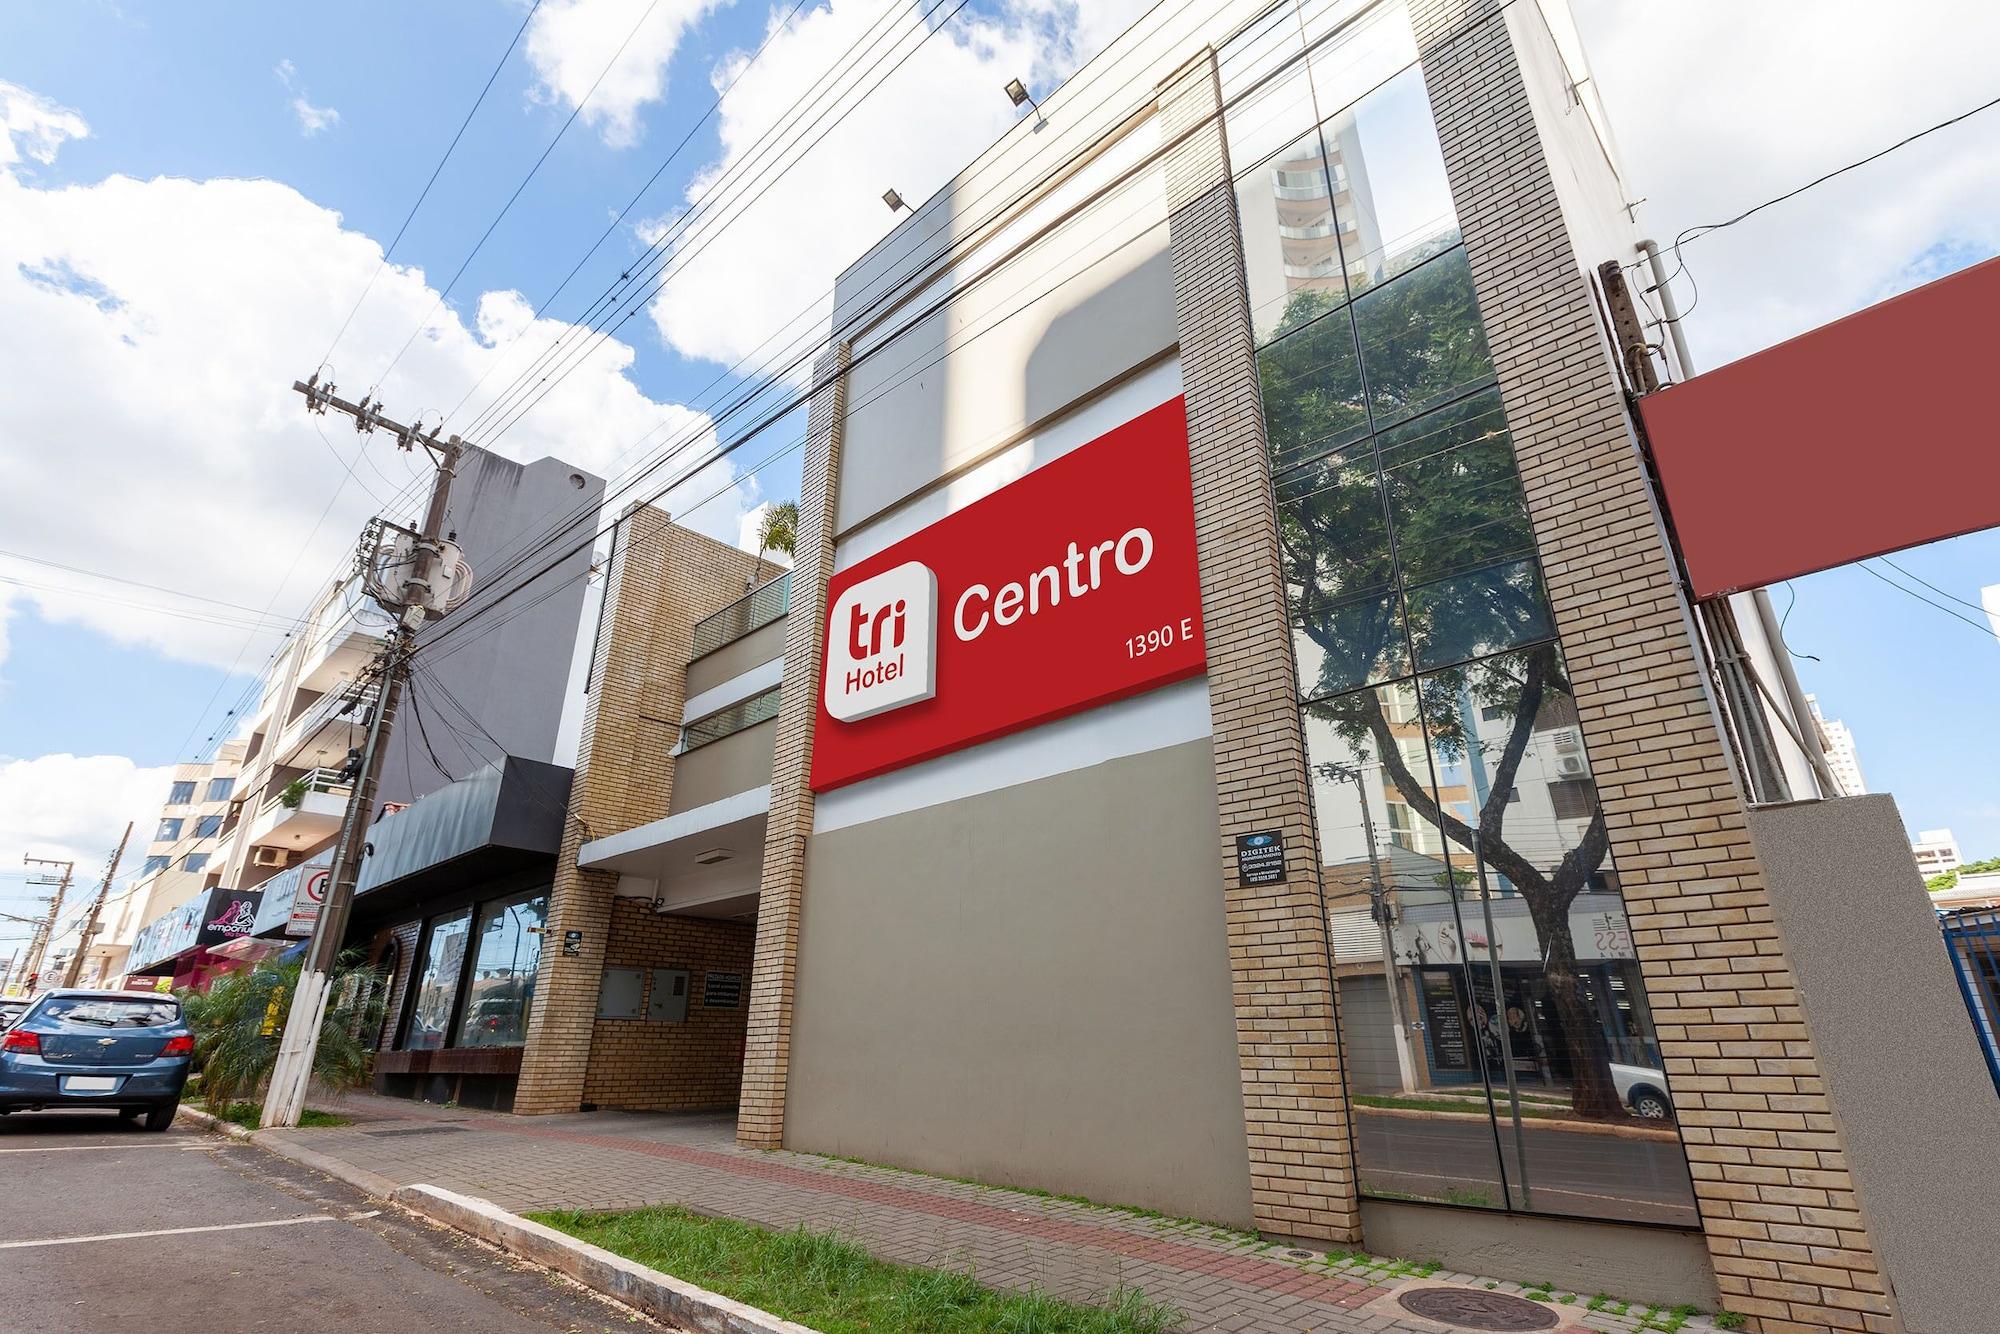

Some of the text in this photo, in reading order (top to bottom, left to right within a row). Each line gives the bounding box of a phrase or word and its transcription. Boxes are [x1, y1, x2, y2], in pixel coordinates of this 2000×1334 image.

[953, 527, 1154, 641] Centro
[848, 599, 908, 661] tri
[1125, 617, 1194, 659] 1390 E
[845, 653, 904, 695] Hotel
[1240, 845, 1281, 857] DIGITEK
[207, 924, 251, 933] emporiu
